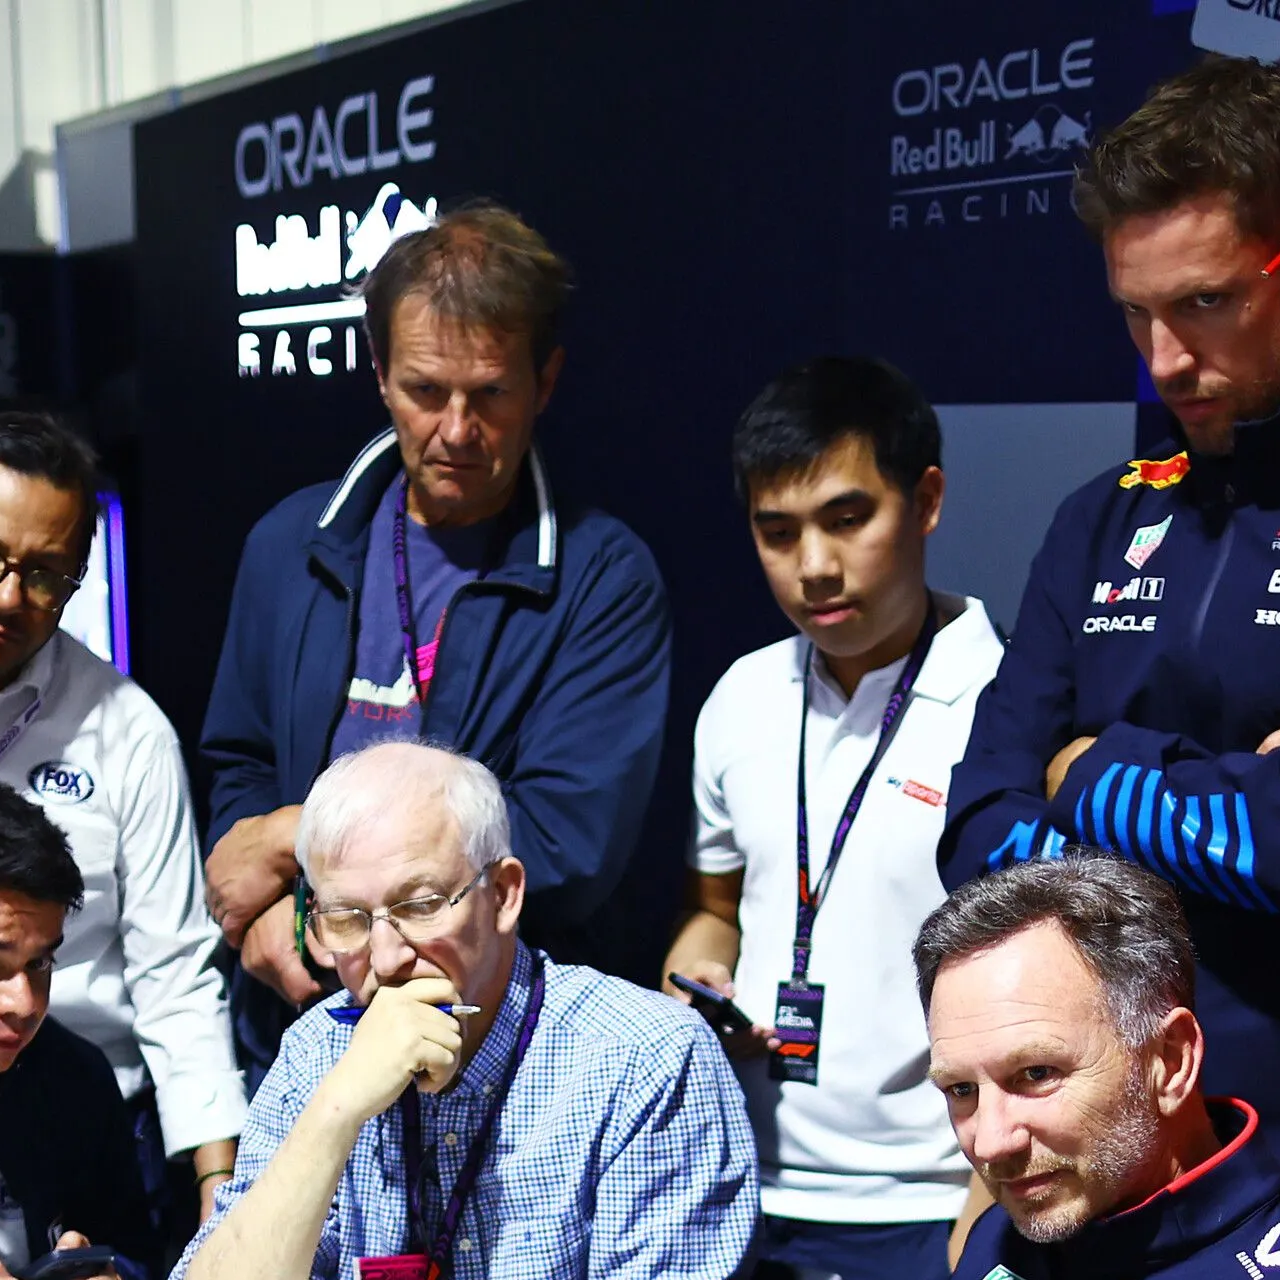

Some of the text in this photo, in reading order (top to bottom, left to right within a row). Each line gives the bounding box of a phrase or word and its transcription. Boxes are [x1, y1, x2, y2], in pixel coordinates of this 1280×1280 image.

[892, 38, 1094, 116] ORACLE
[235, 75, 437, 198] ORACLE
[889, 188, 1050, 230] RACIN
[238, 326, 362, 378] RACI
[1083, 615, 1157, 633] ORACLE
[43, 768, 81, 793] FOX
